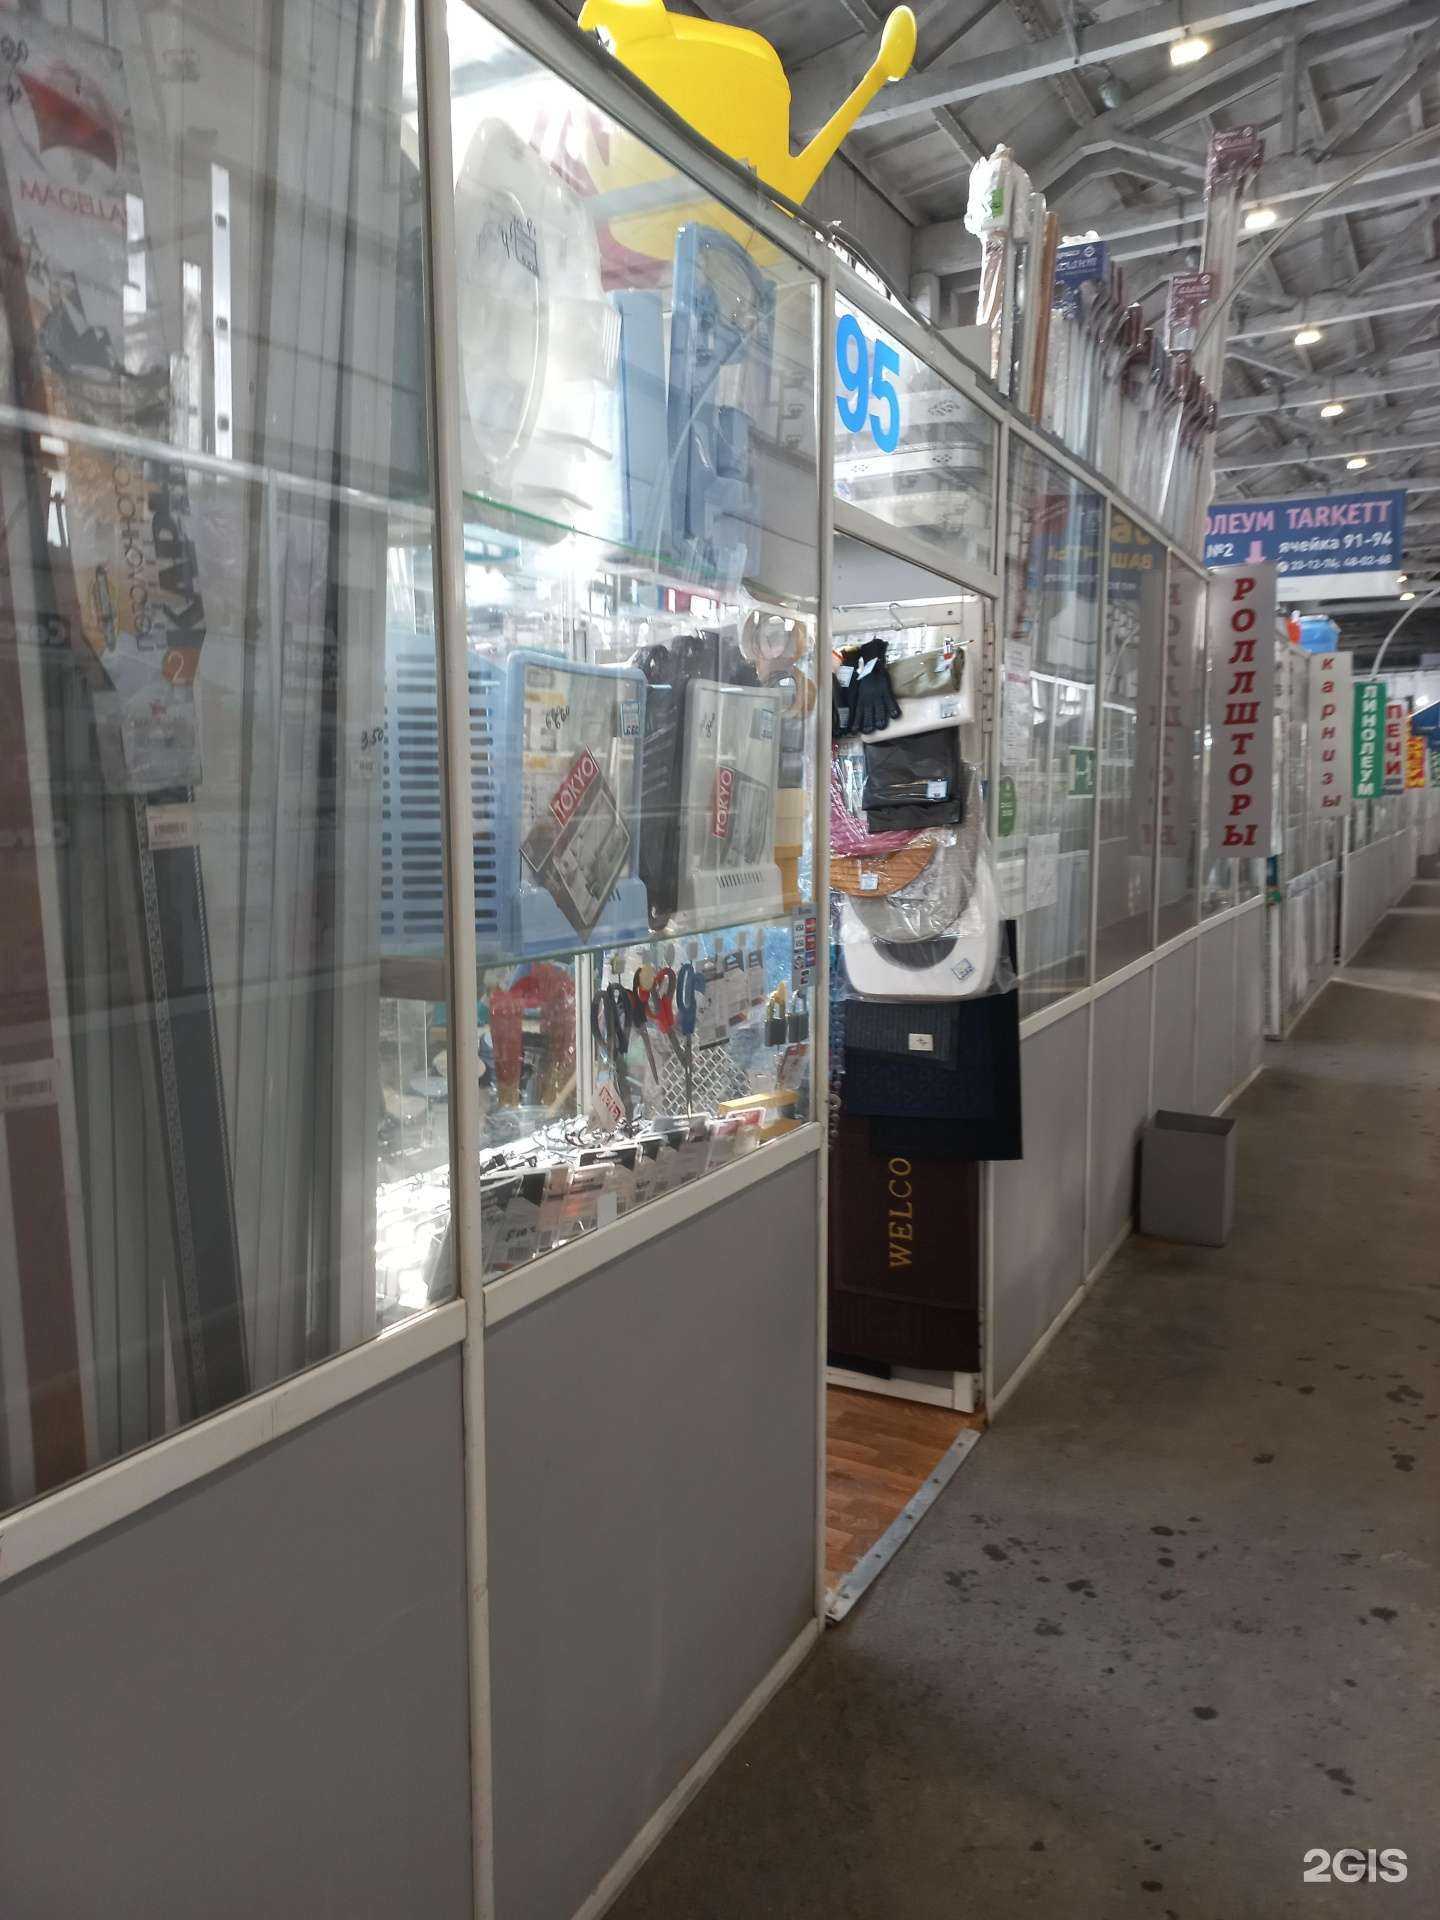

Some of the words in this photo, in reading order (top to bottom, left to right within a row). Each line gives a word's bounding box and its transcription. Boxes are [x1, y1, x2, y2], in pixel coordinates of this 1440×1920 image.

[836, 314, 900, 454] 95
[1285, 500, 1393, 531] TARKETT
[1343, 531, 1394, 550] 91-94
[167, 651, 187, 685] 2
[1222, 577, 1260, 847] РОЛЛШТОРЫ
[1320, 657, 1342, 808] карнизы
[1357, 685, 1379, 796] ЛИНОЛЕУМ
[1385, 703, 1402, 775] ПЕЧИ
[553, 756, 594, 820] TOKYO
[715, 769, 733, 835] TOKYO
[888, 1157, 913, 1267] WELCO
